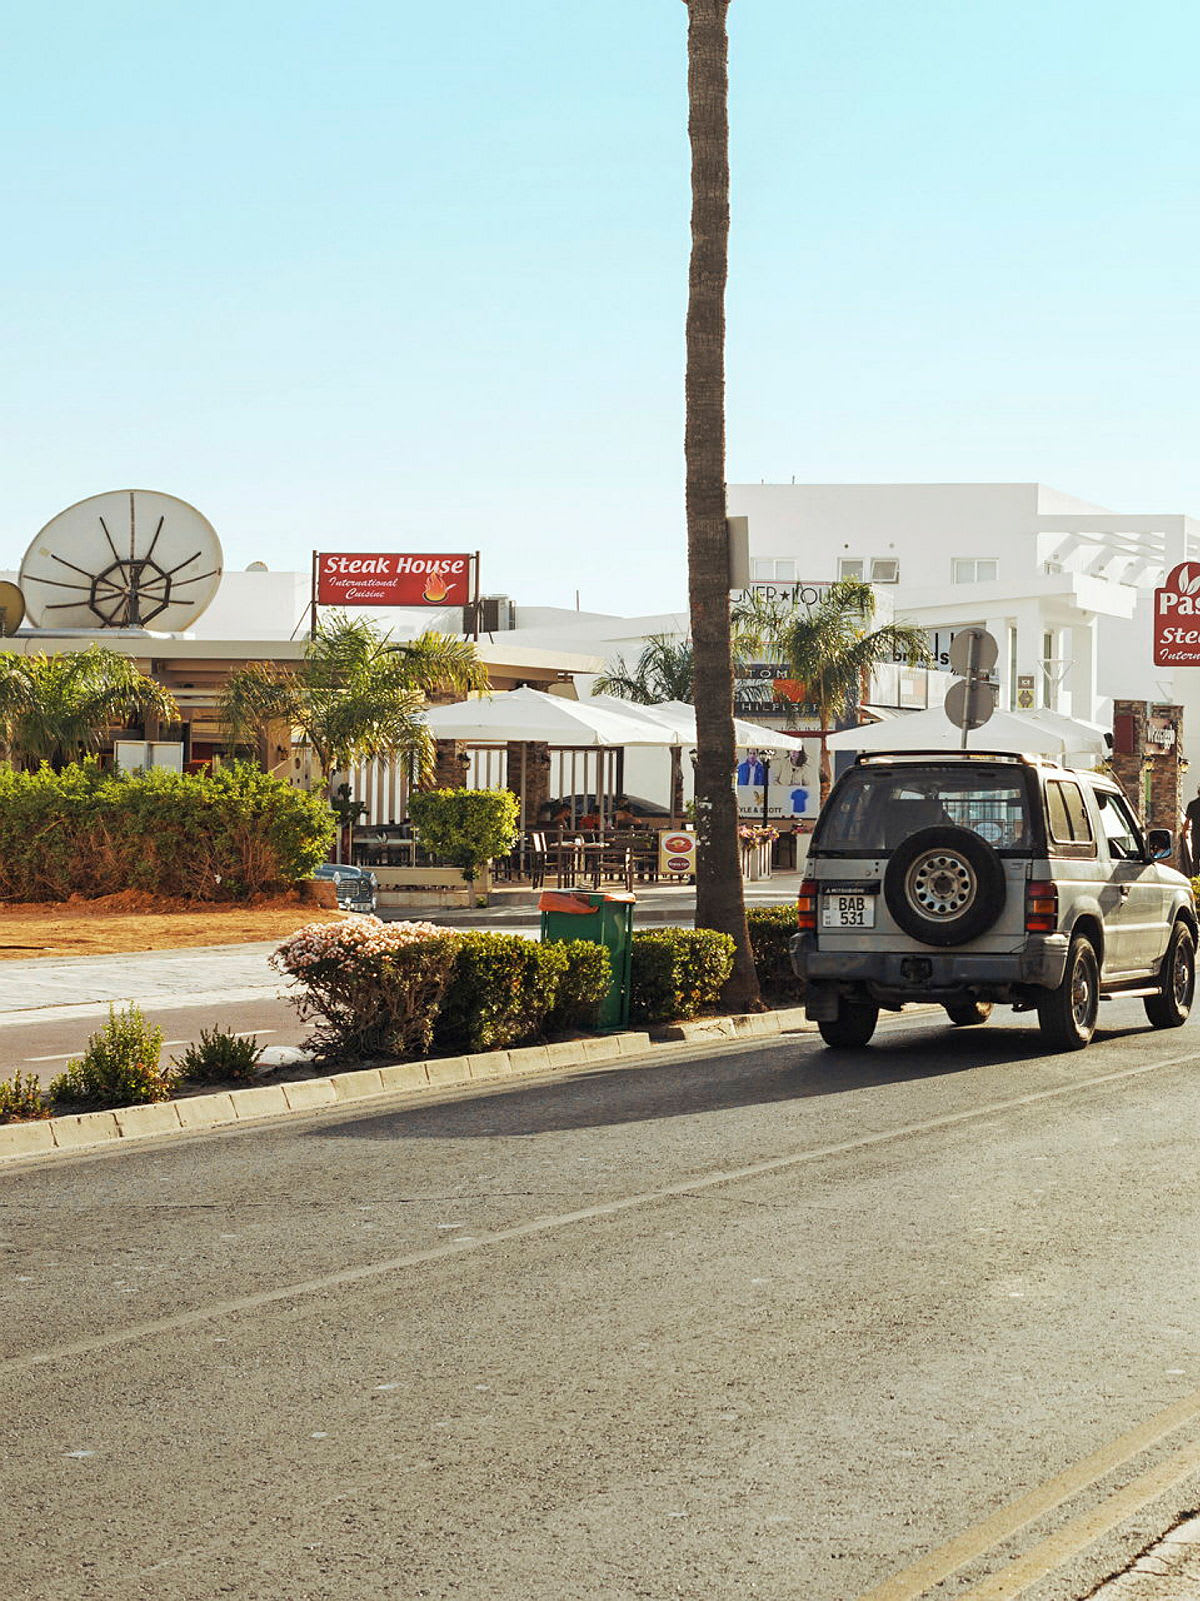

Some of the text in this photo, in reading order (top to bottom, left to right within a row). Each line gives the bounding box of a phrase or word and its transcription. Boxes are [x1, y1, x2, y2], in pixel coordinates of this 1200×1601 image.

[324, 556, 464, 574] Steak House
[328, 576, 398, 587] International
[345, 588, 385, 600] Cuisine
[838, 897, 865, 910] BAB
[840, 912, 865, 925] 531
